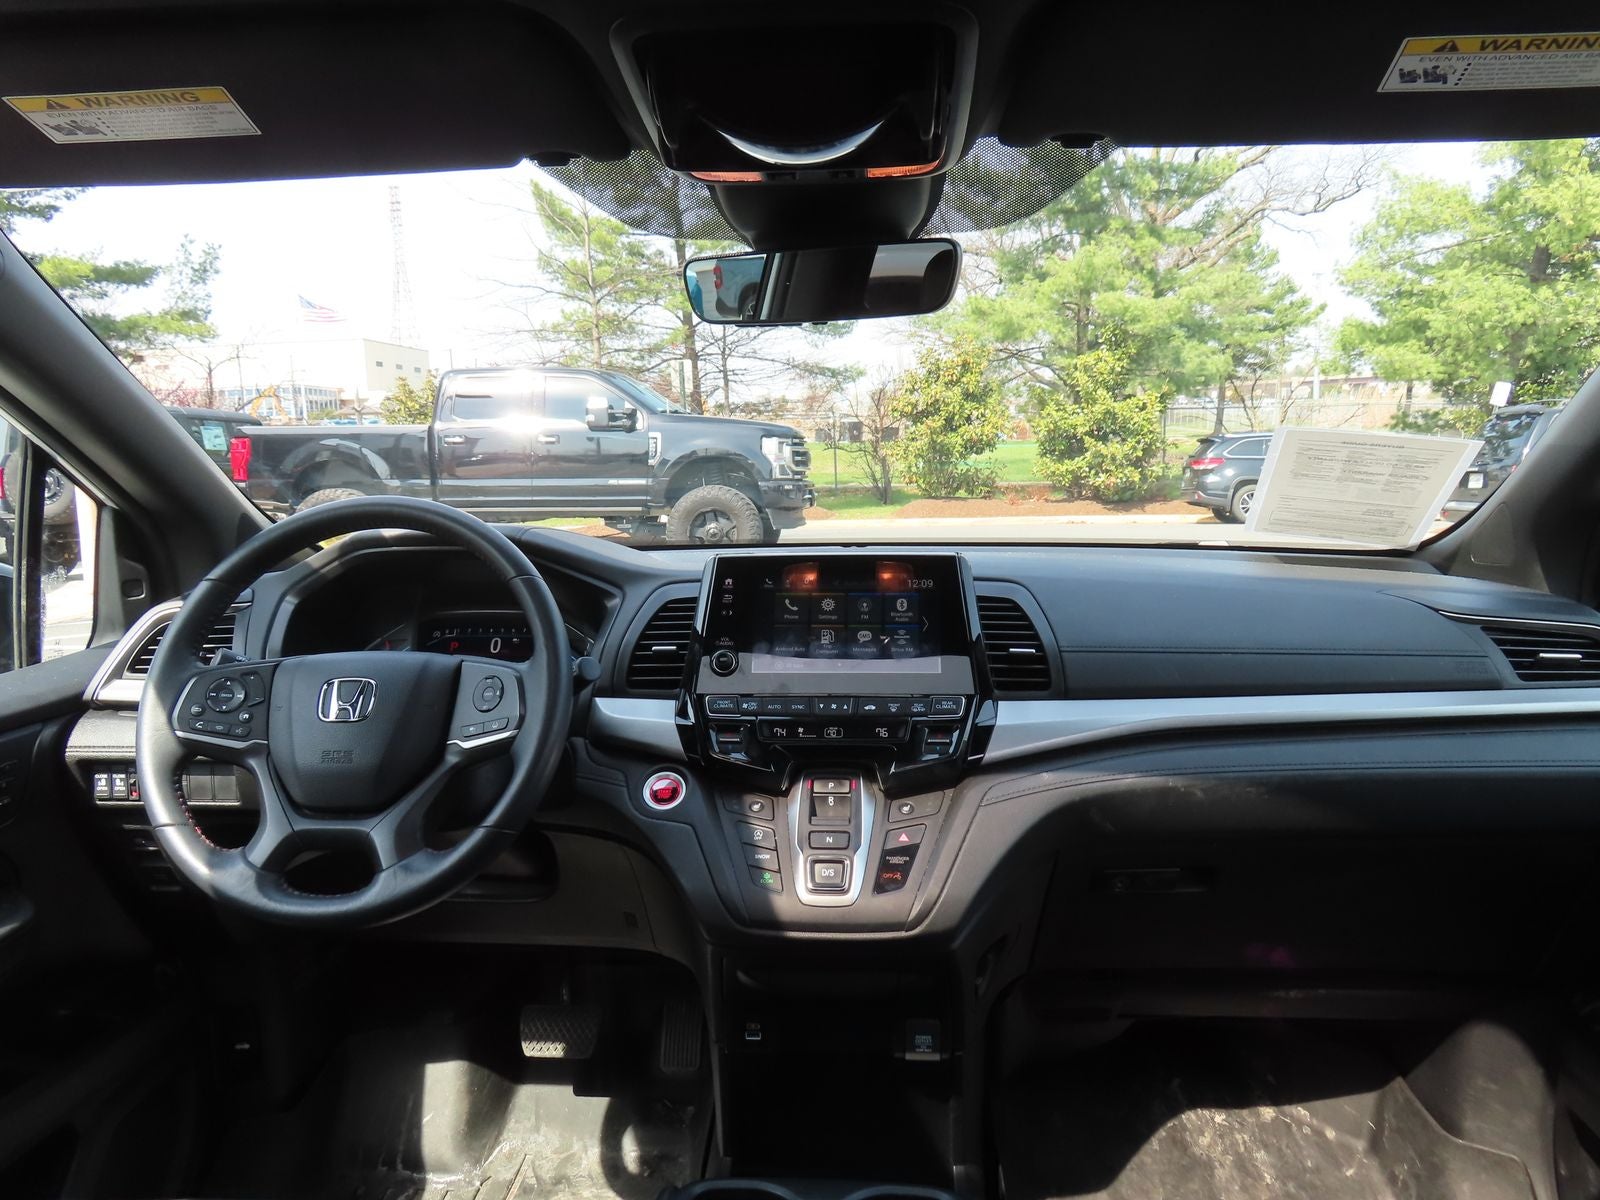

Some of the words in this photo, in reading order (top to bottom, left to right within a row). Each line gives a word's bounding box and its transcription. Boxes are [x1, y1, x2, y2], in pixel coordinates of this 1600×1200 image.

[1479, 36, 1600, 51] WARNIN
[1488, 53, 1559, 61] ADVANCED
[74, 91, 200, 108] WARNING
[46, 110, 78, 119] EVEN
[906, 579, 934, 588] 12:09
[490, 637, 501, 653] 0
[773, 727, 787, 737] 74
[875, 727, 889, 738] 76
[821, 868, 835, 877] D/S
